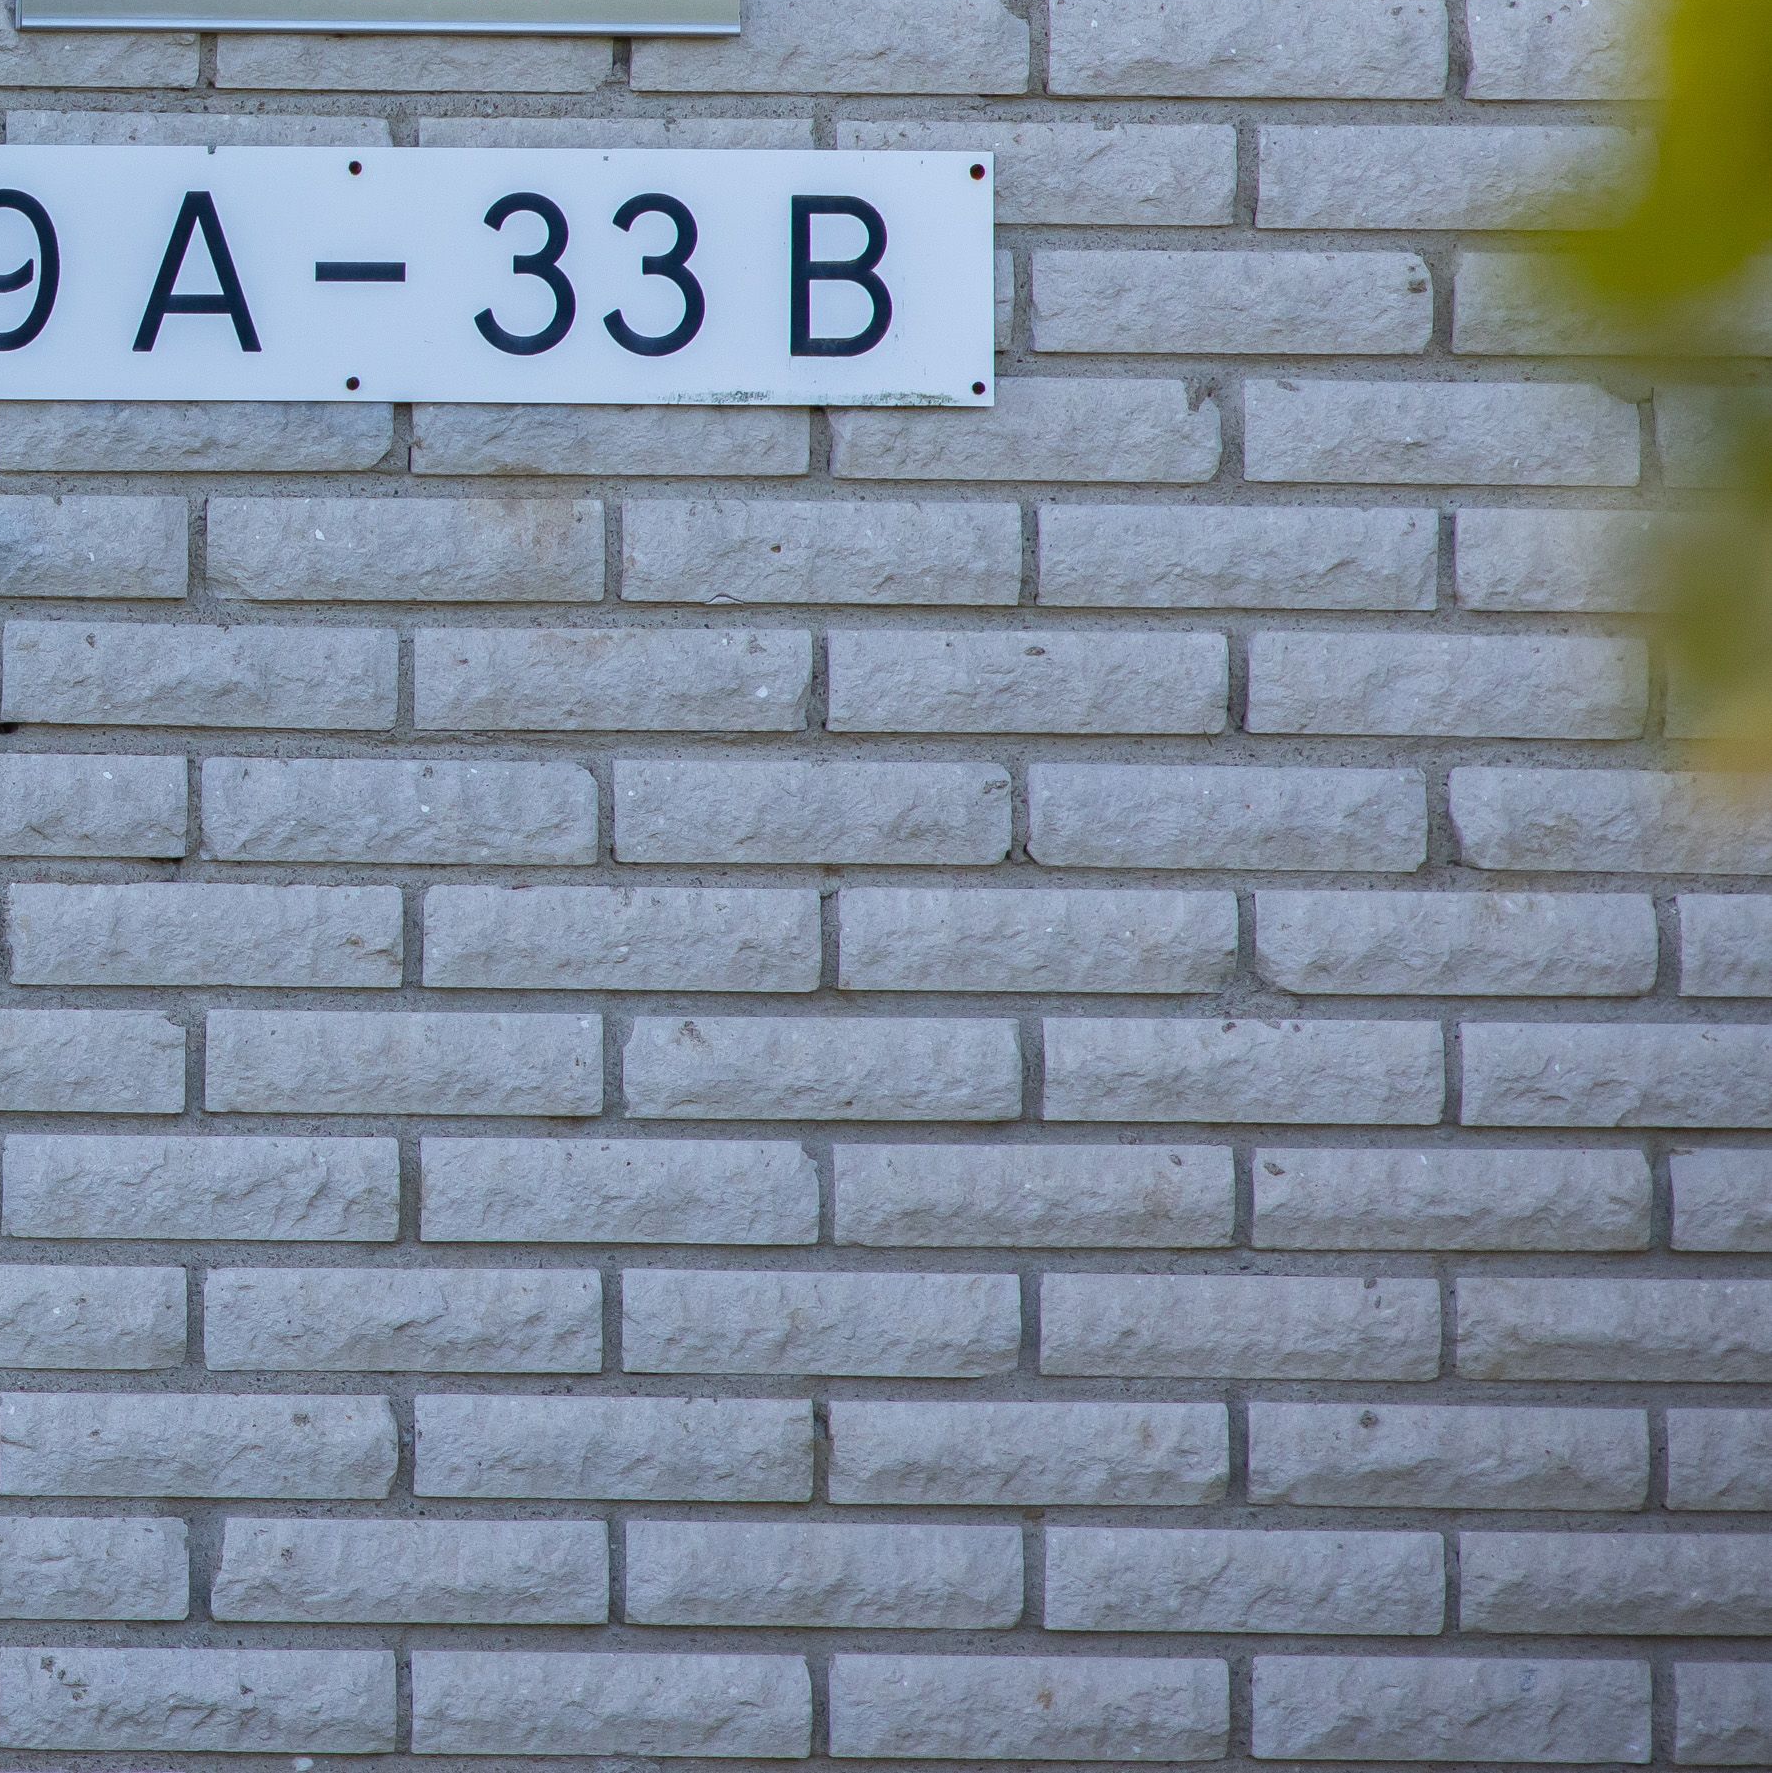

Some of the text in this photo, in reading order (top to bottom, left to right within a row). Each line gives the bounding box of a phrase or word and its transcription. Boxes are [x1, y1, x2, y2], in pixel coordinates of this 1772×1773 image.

[132, 190, 263, 353] A
[473, 192, 706, 358] 33
[789, 194, 894, 359] B
